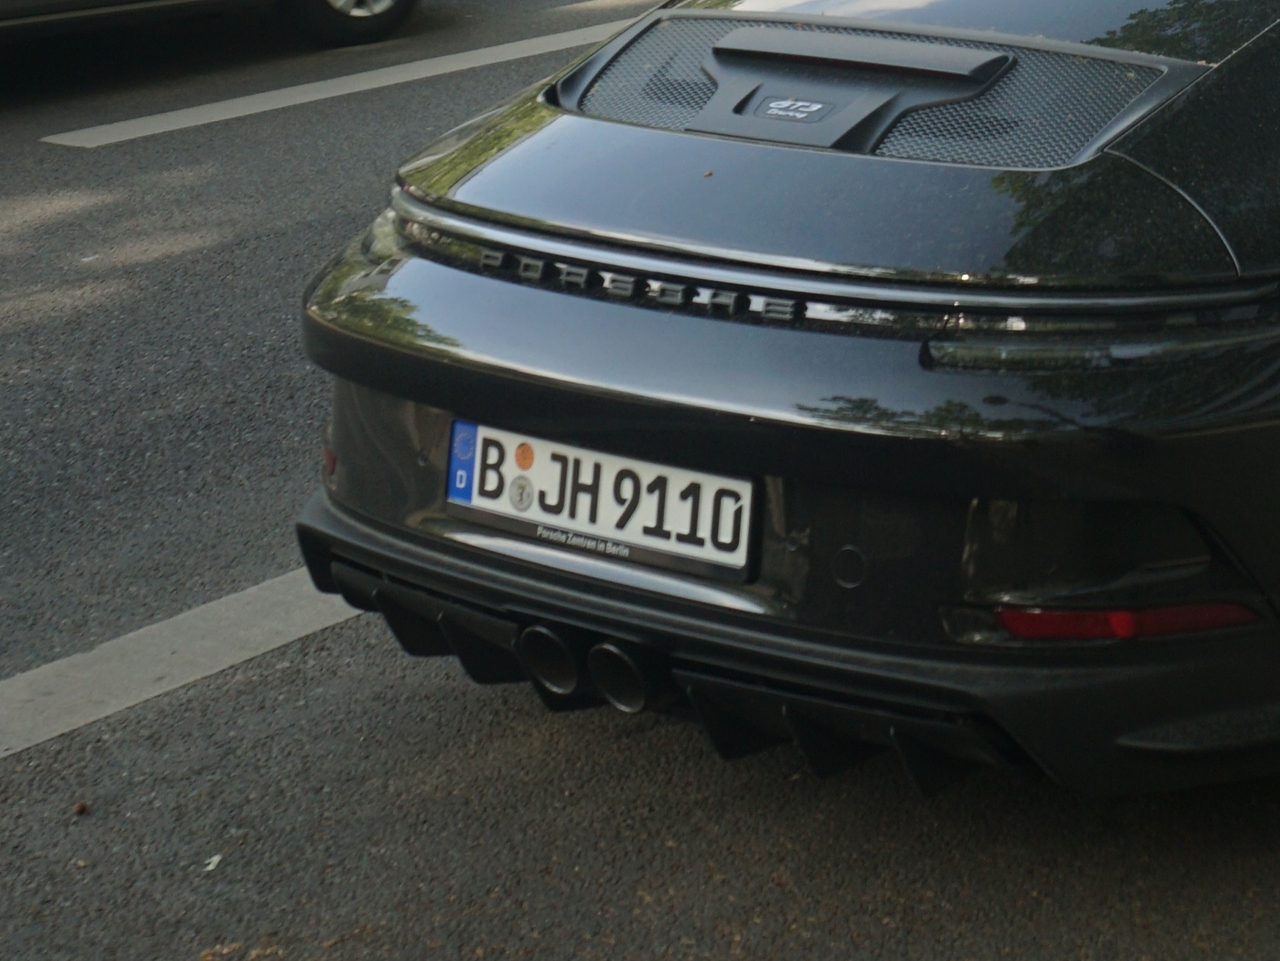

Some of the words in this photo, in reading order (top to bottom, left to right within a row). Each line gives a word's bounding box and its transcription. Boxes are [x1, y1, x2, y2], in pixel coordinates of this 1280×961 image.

[480, 248, 797, 321] PORSCHE
[455, 469, 467, 489] D
[478, 437, 506, 500] B
[538, 451, 602, 525] JH
[613, 468, 744, 553] 9110
[537, 525, 567, 544] Porsche
[566, 532, 597, 550] Zentren
[597, 540, 606, 552] in
[606, 541, 630, 557] Berlin
